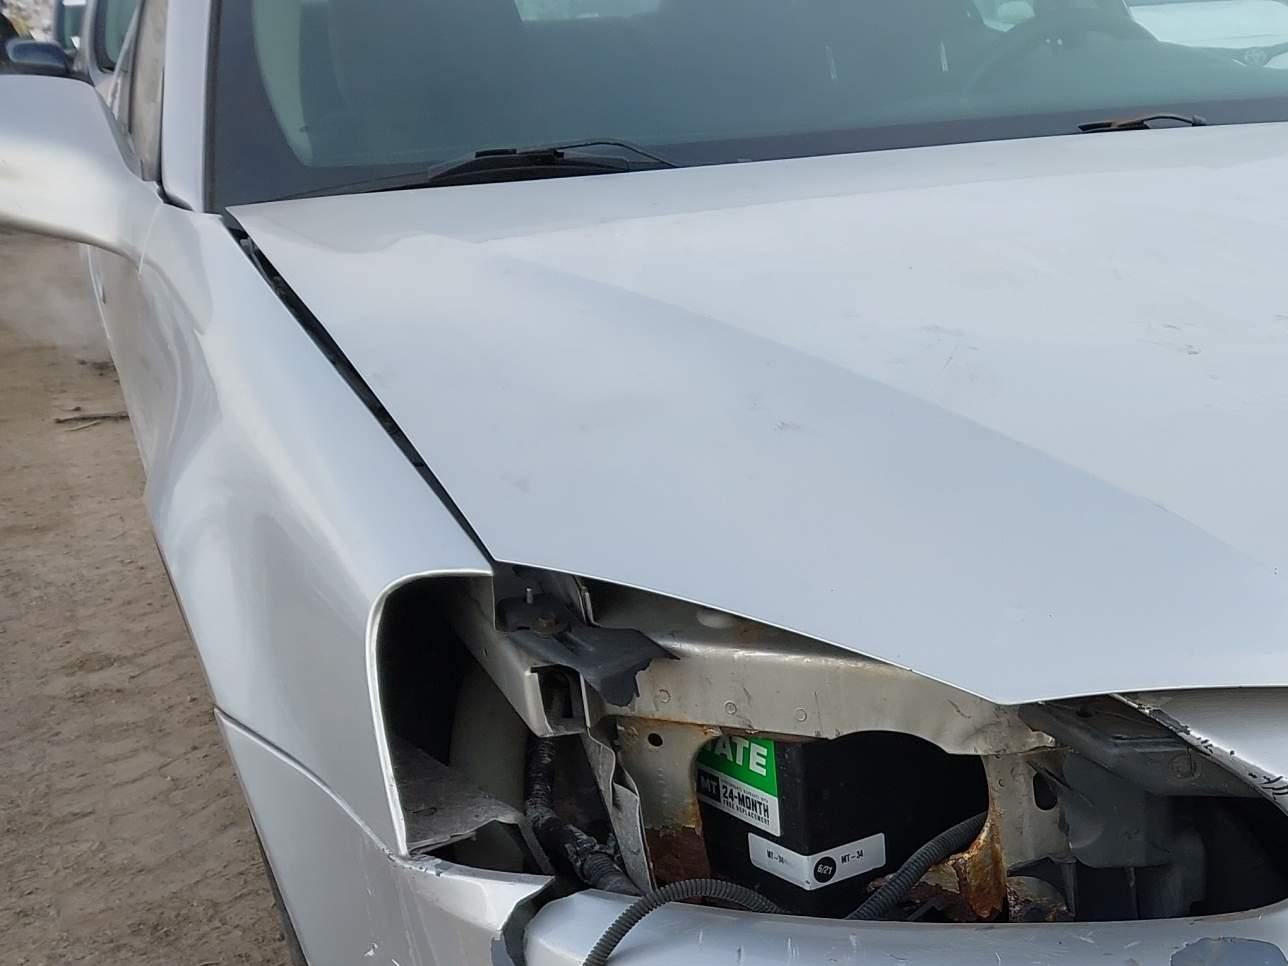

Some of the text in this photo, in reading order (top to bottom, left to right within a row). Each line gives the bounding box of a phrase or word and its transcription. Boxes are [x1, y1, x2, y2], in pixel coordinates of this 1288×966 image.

[705, 736, 768, 776] ATE
[722, 784, 770, 819] 24-MONTH
[841, 849, 864, 864] MT-34
[816, 864, 833, 875] 6/21
